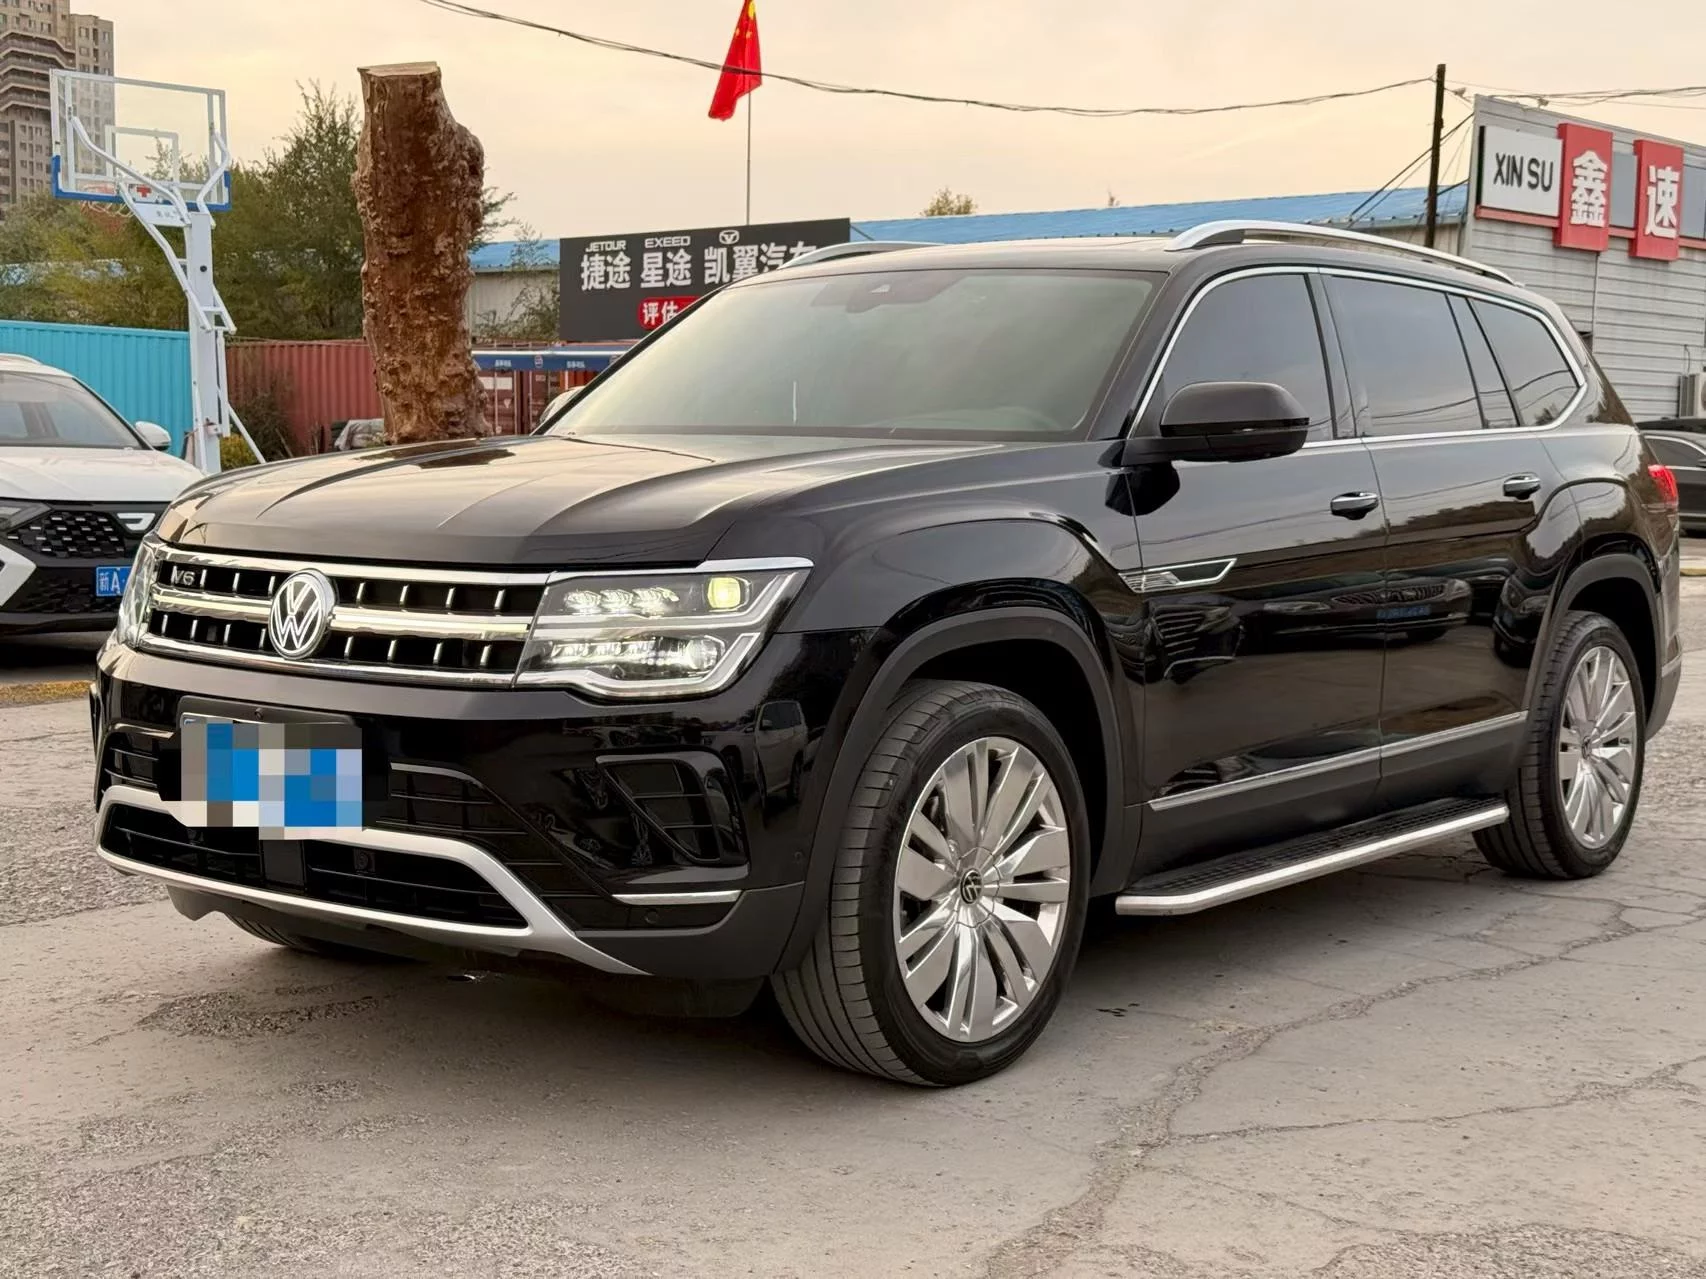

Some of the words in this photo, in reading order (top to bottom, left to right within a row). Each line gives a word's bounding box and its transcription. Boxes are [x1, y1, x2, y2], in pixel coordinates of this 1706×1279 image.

[1493, 152, 1523, 188] XIN
[1528, 158, 1553, 193] SU
[585, 240, 626, 252] JETOUR
[644, 236, 691, 249] EXEED
[581, 251, 631, 291] 捷途
[640, 248, 692, 288] 星途
[172, 569, 195, 586] V6
